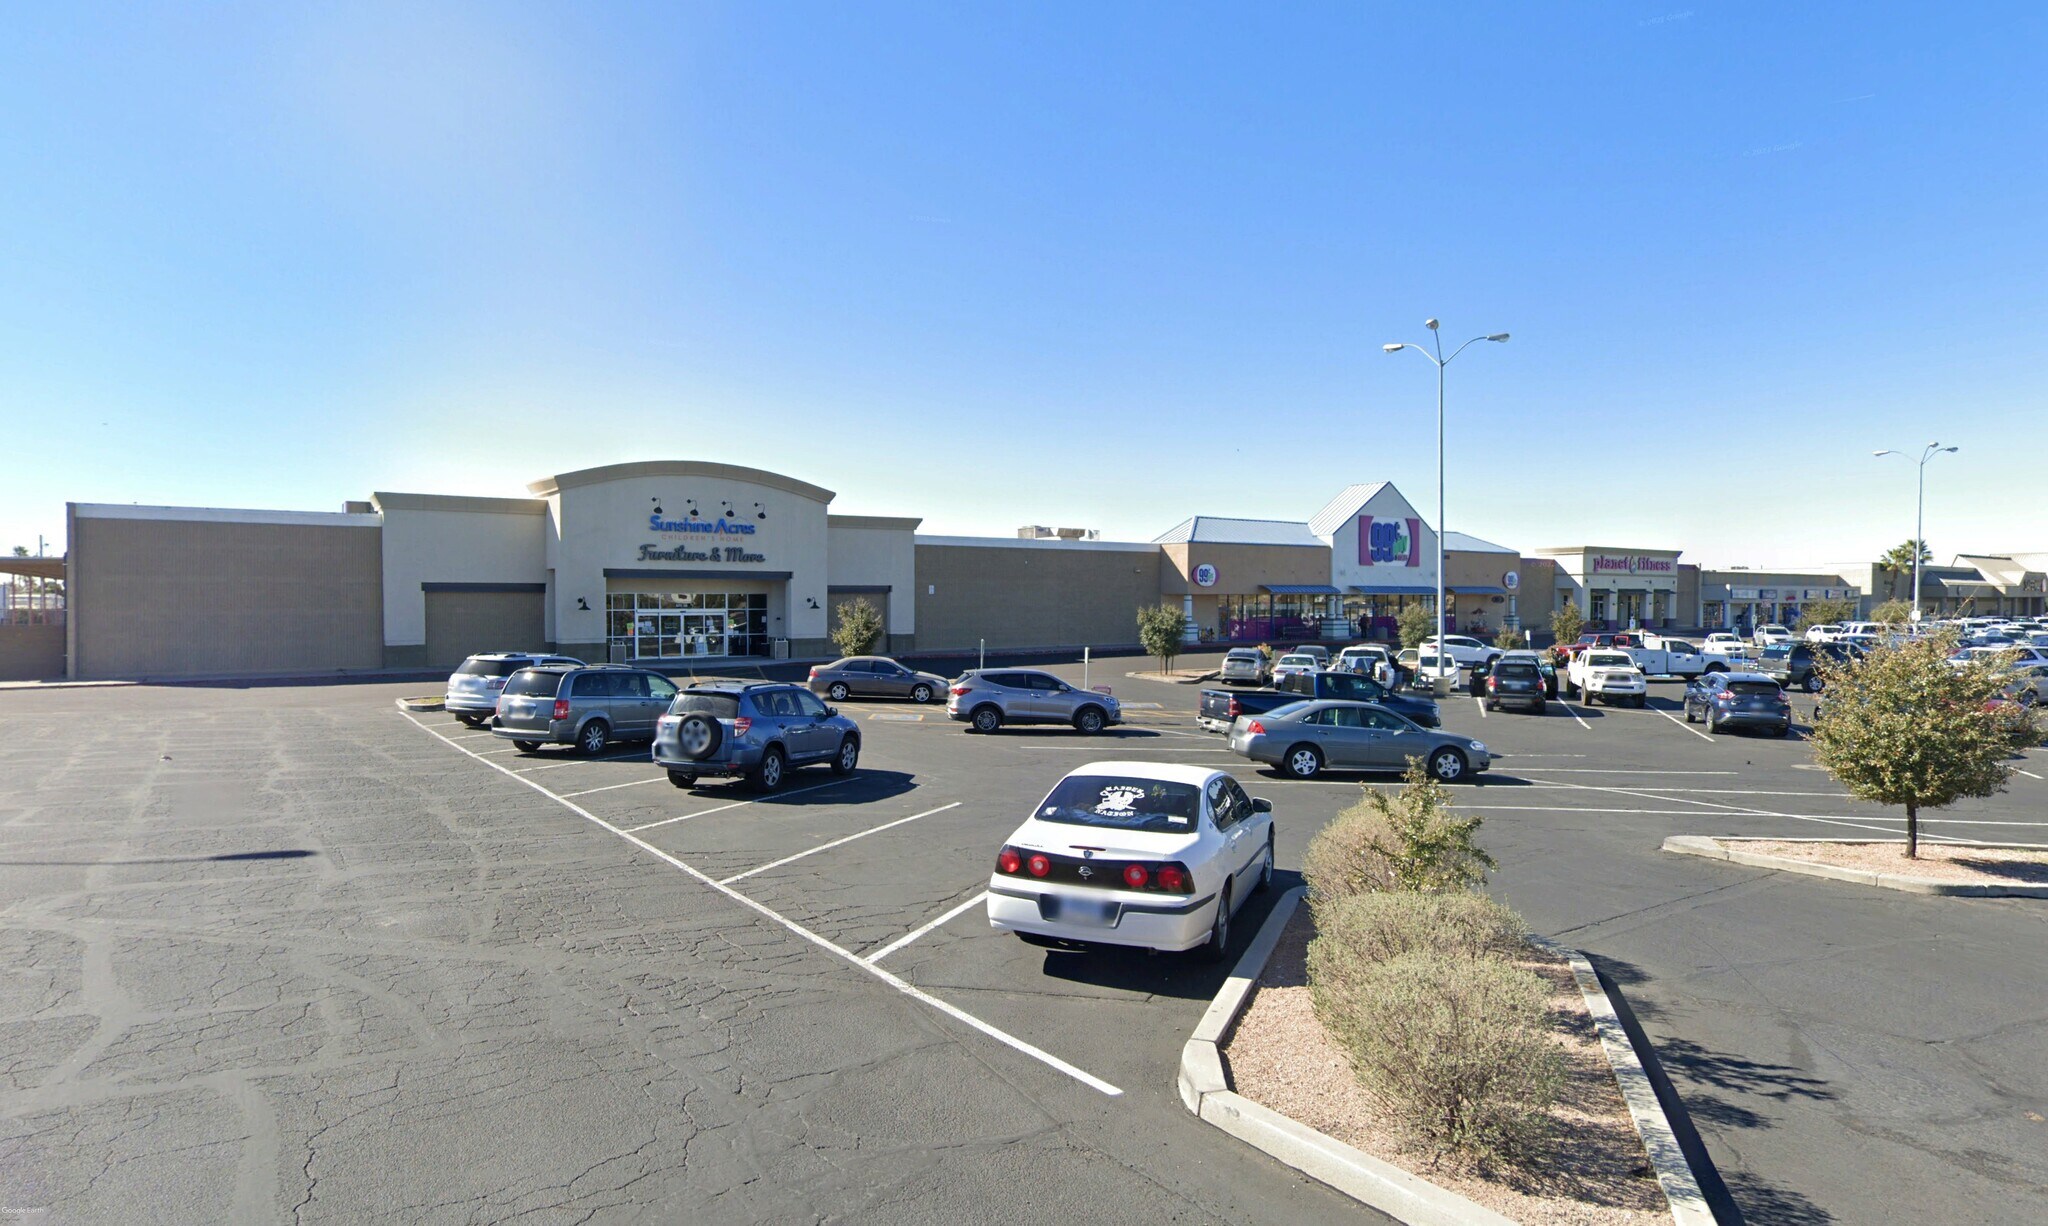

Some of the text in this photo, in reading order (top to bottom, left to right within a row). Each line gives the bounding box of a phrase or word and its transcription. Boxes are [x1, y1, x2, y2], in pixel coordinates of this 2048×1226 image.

[649, 515, 755, 535] Sunshine Acres
[719, 535, 744, 543] HOME
[637, 543, 766, 563] Furniture & More
[1593, 554, 1672, 573] planet fitness
